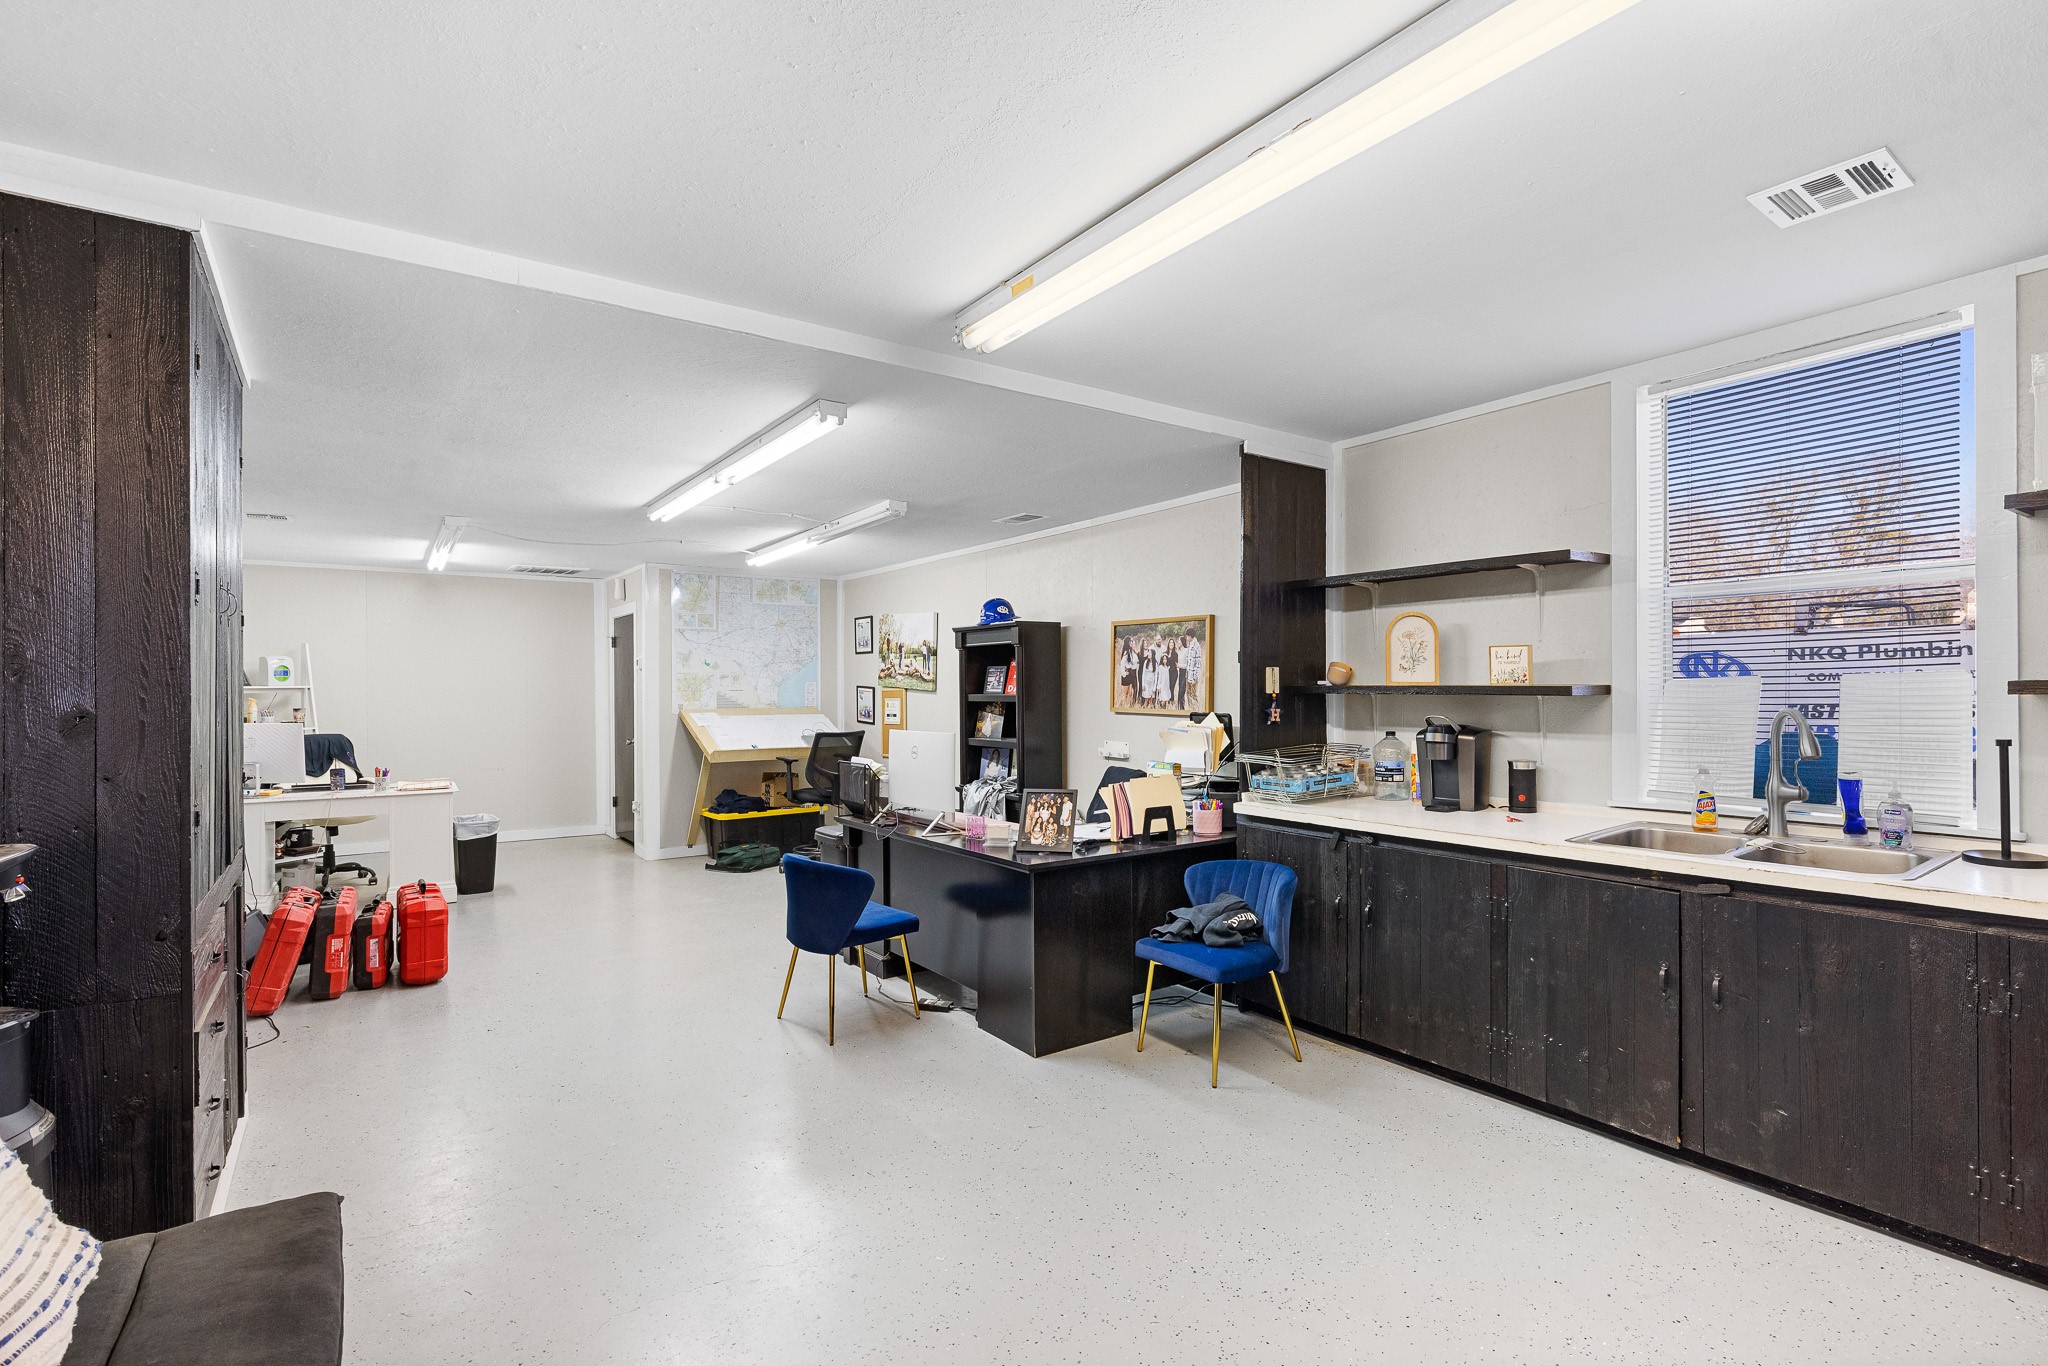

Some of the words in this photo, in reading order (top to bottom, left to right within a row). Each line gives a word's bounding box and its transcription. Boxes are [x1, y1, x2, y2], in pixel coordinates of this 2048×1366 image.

[1787, 646, 1847, 661] NKQ
[1270, 708, 1281, 722] H
[1697, 800, 1714, 810] AJAX
